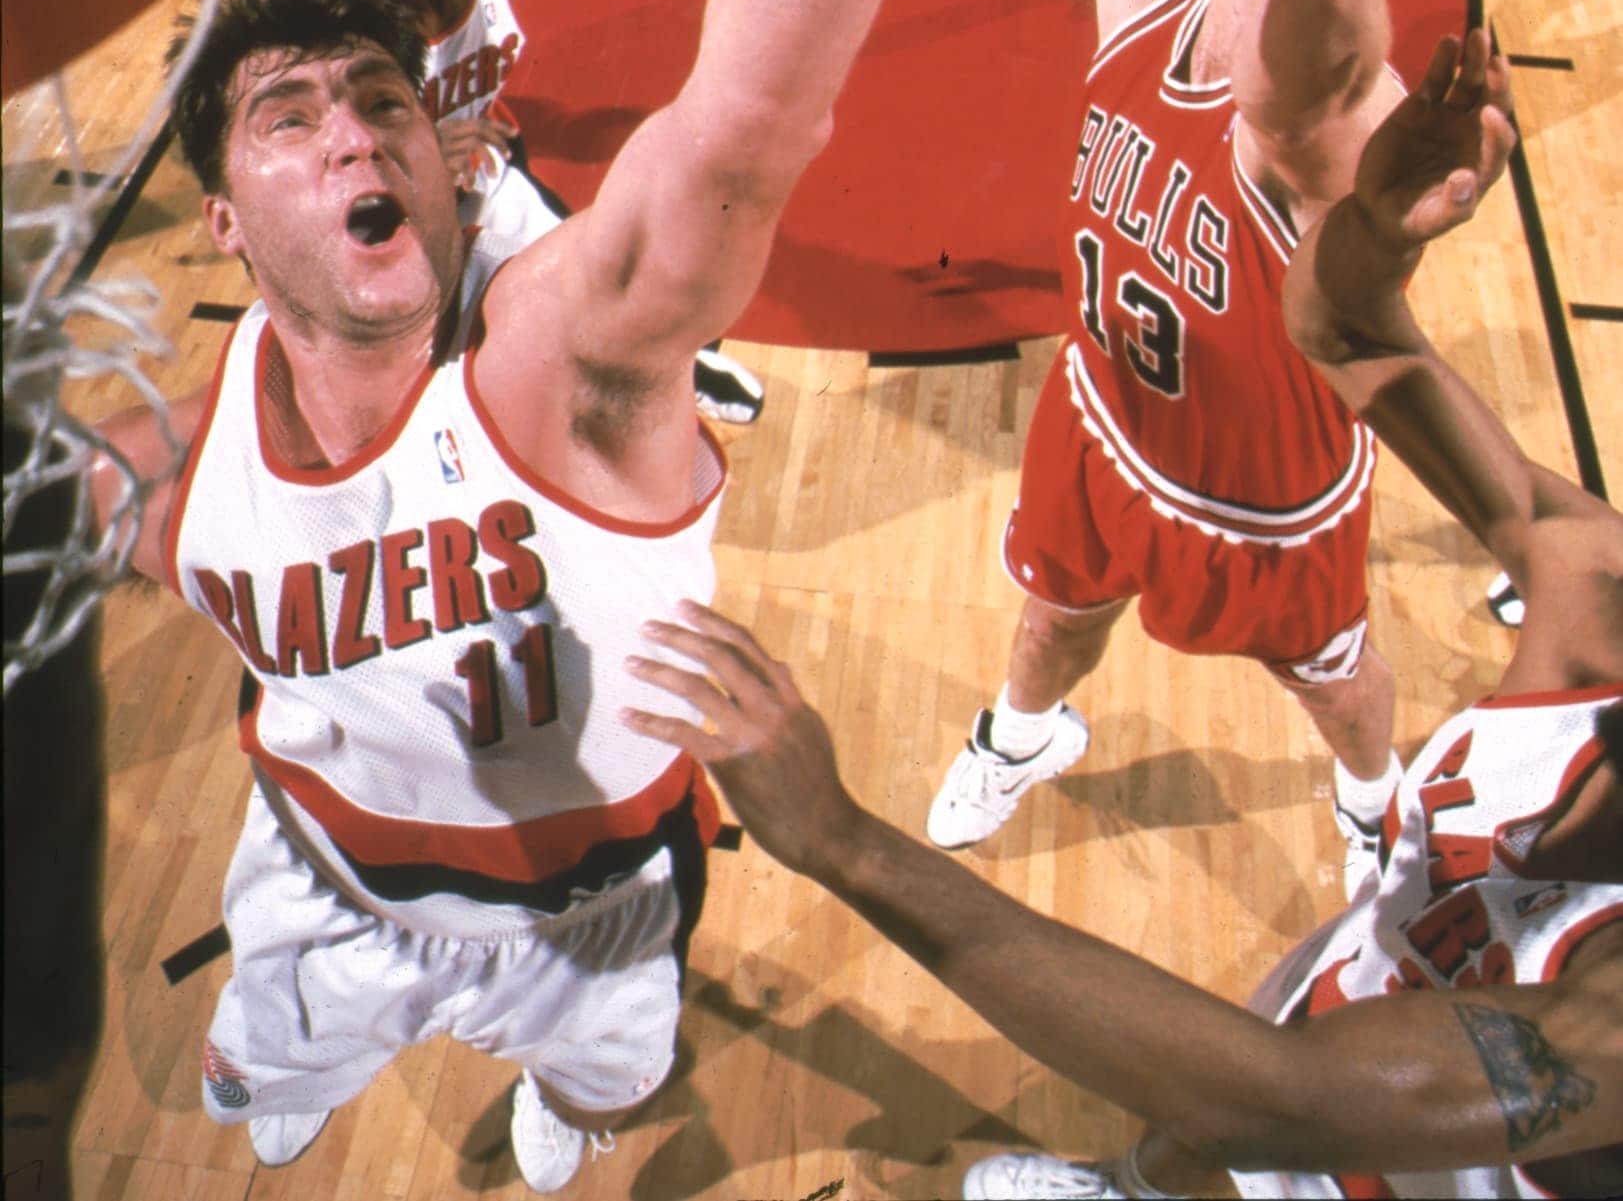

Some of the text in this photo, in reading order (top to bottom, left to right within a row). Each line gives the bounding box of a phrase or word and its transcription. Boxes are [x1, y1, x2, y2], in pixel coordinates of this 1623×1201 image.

[1070, 104, 1229, 316] BULLS
[1075, 228, 1186, 400] 13
[193, 499, 548, 678] BLAZERS
[455, 623, 559, 748] 11
